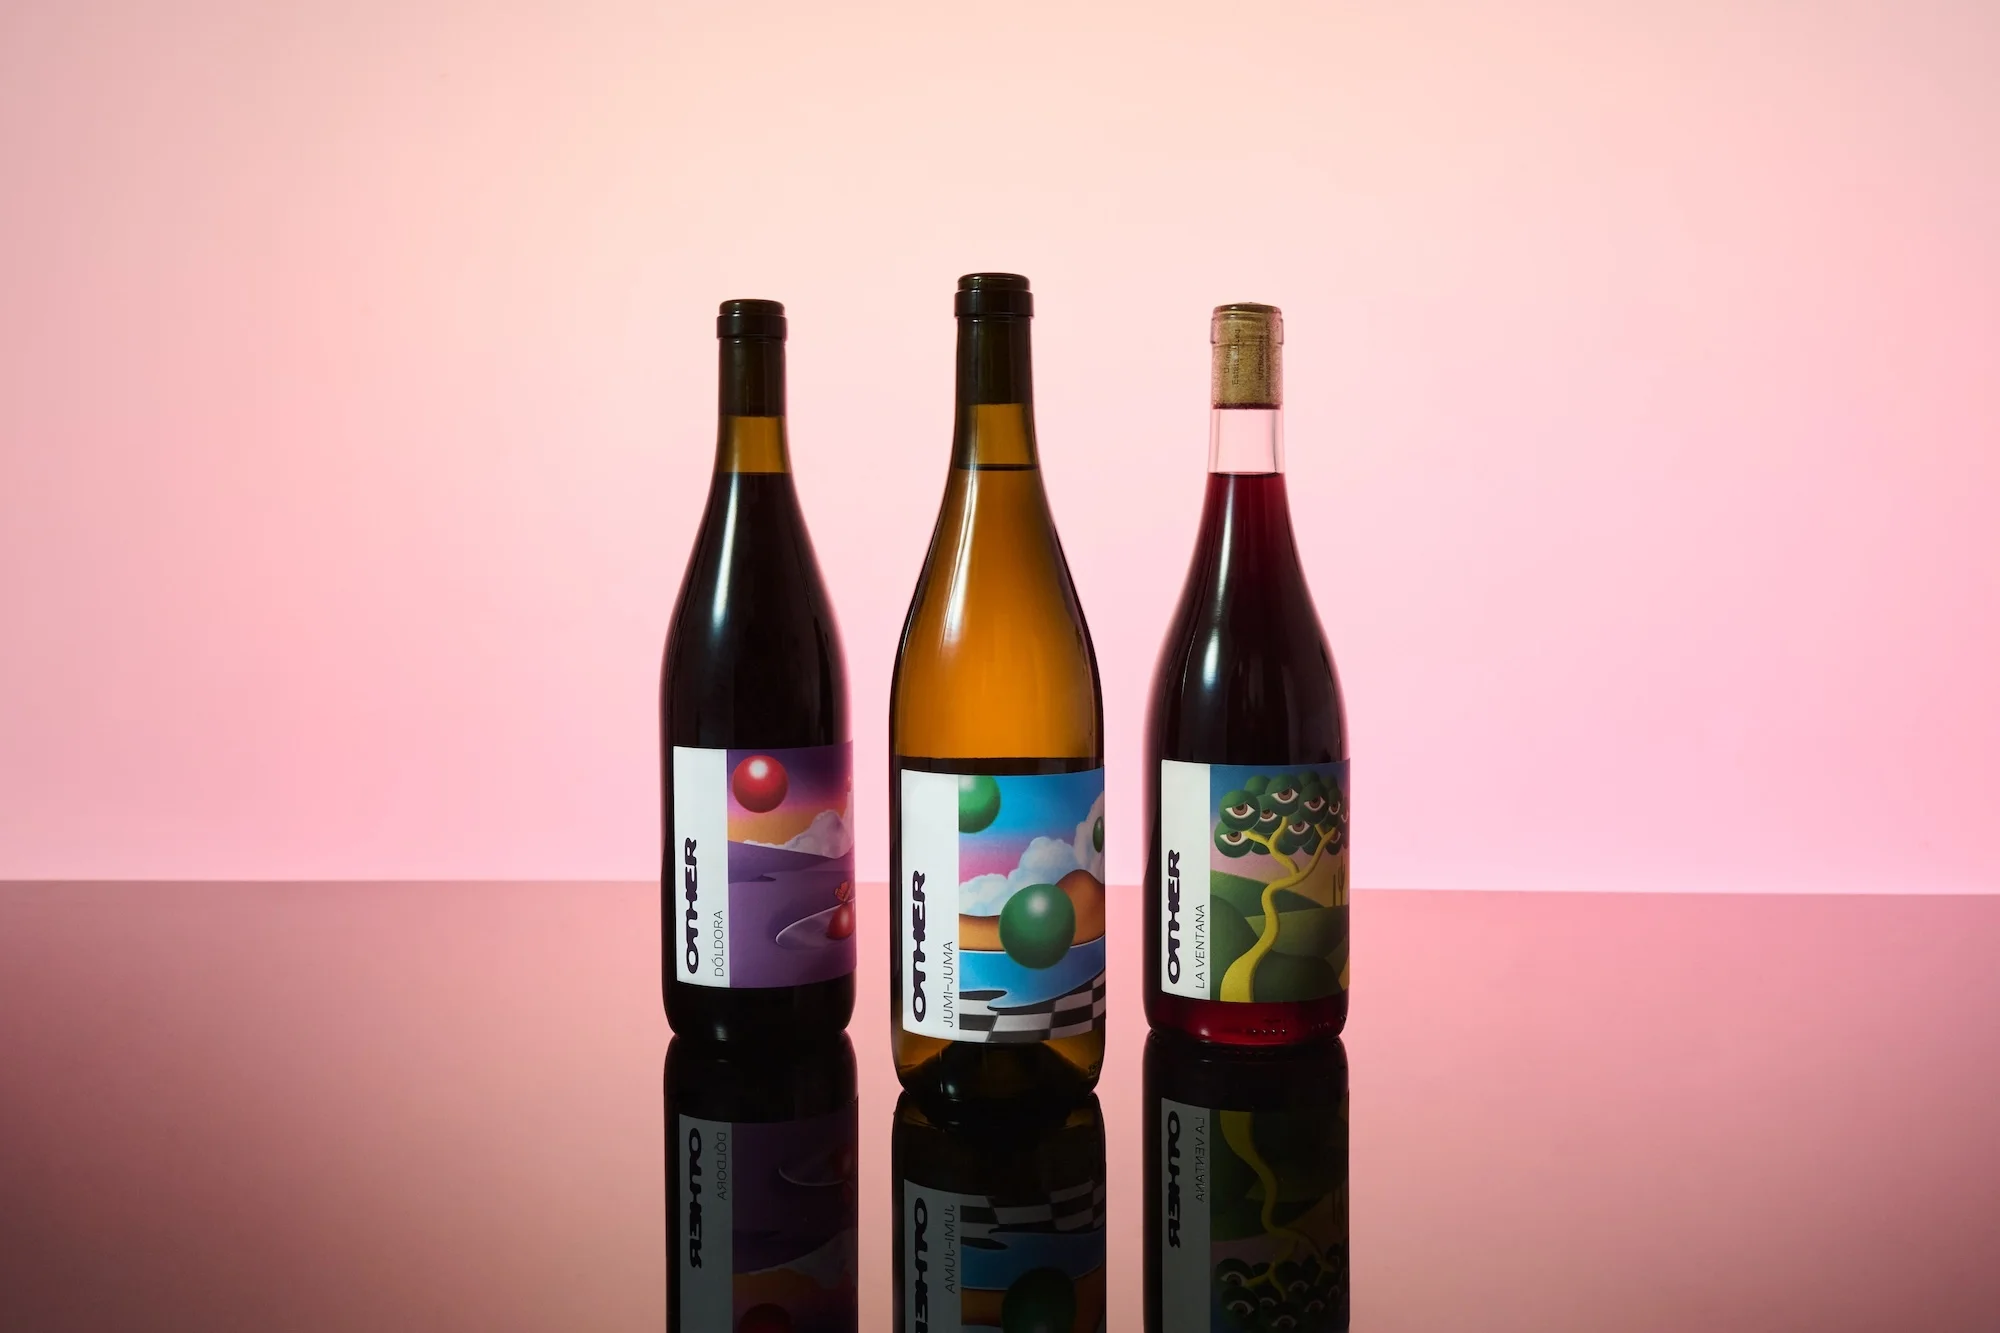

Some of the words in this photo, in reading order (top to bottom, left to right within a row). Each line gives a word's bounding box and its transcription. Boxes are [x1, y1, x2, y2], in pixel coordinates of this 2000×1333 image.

[684, 837, 699, 974] OTHER
[711, 910, 724, 977] DÓLDORA
[912, 870, 927, 1023] OTHER
[1167, 849, 1181, 985] OTHER
[1195, 904, 1205, 967] VENTANA
[942, 941, 954, 1028] JUMI-JUMA
[1195, 971, 1205, 989] LA
